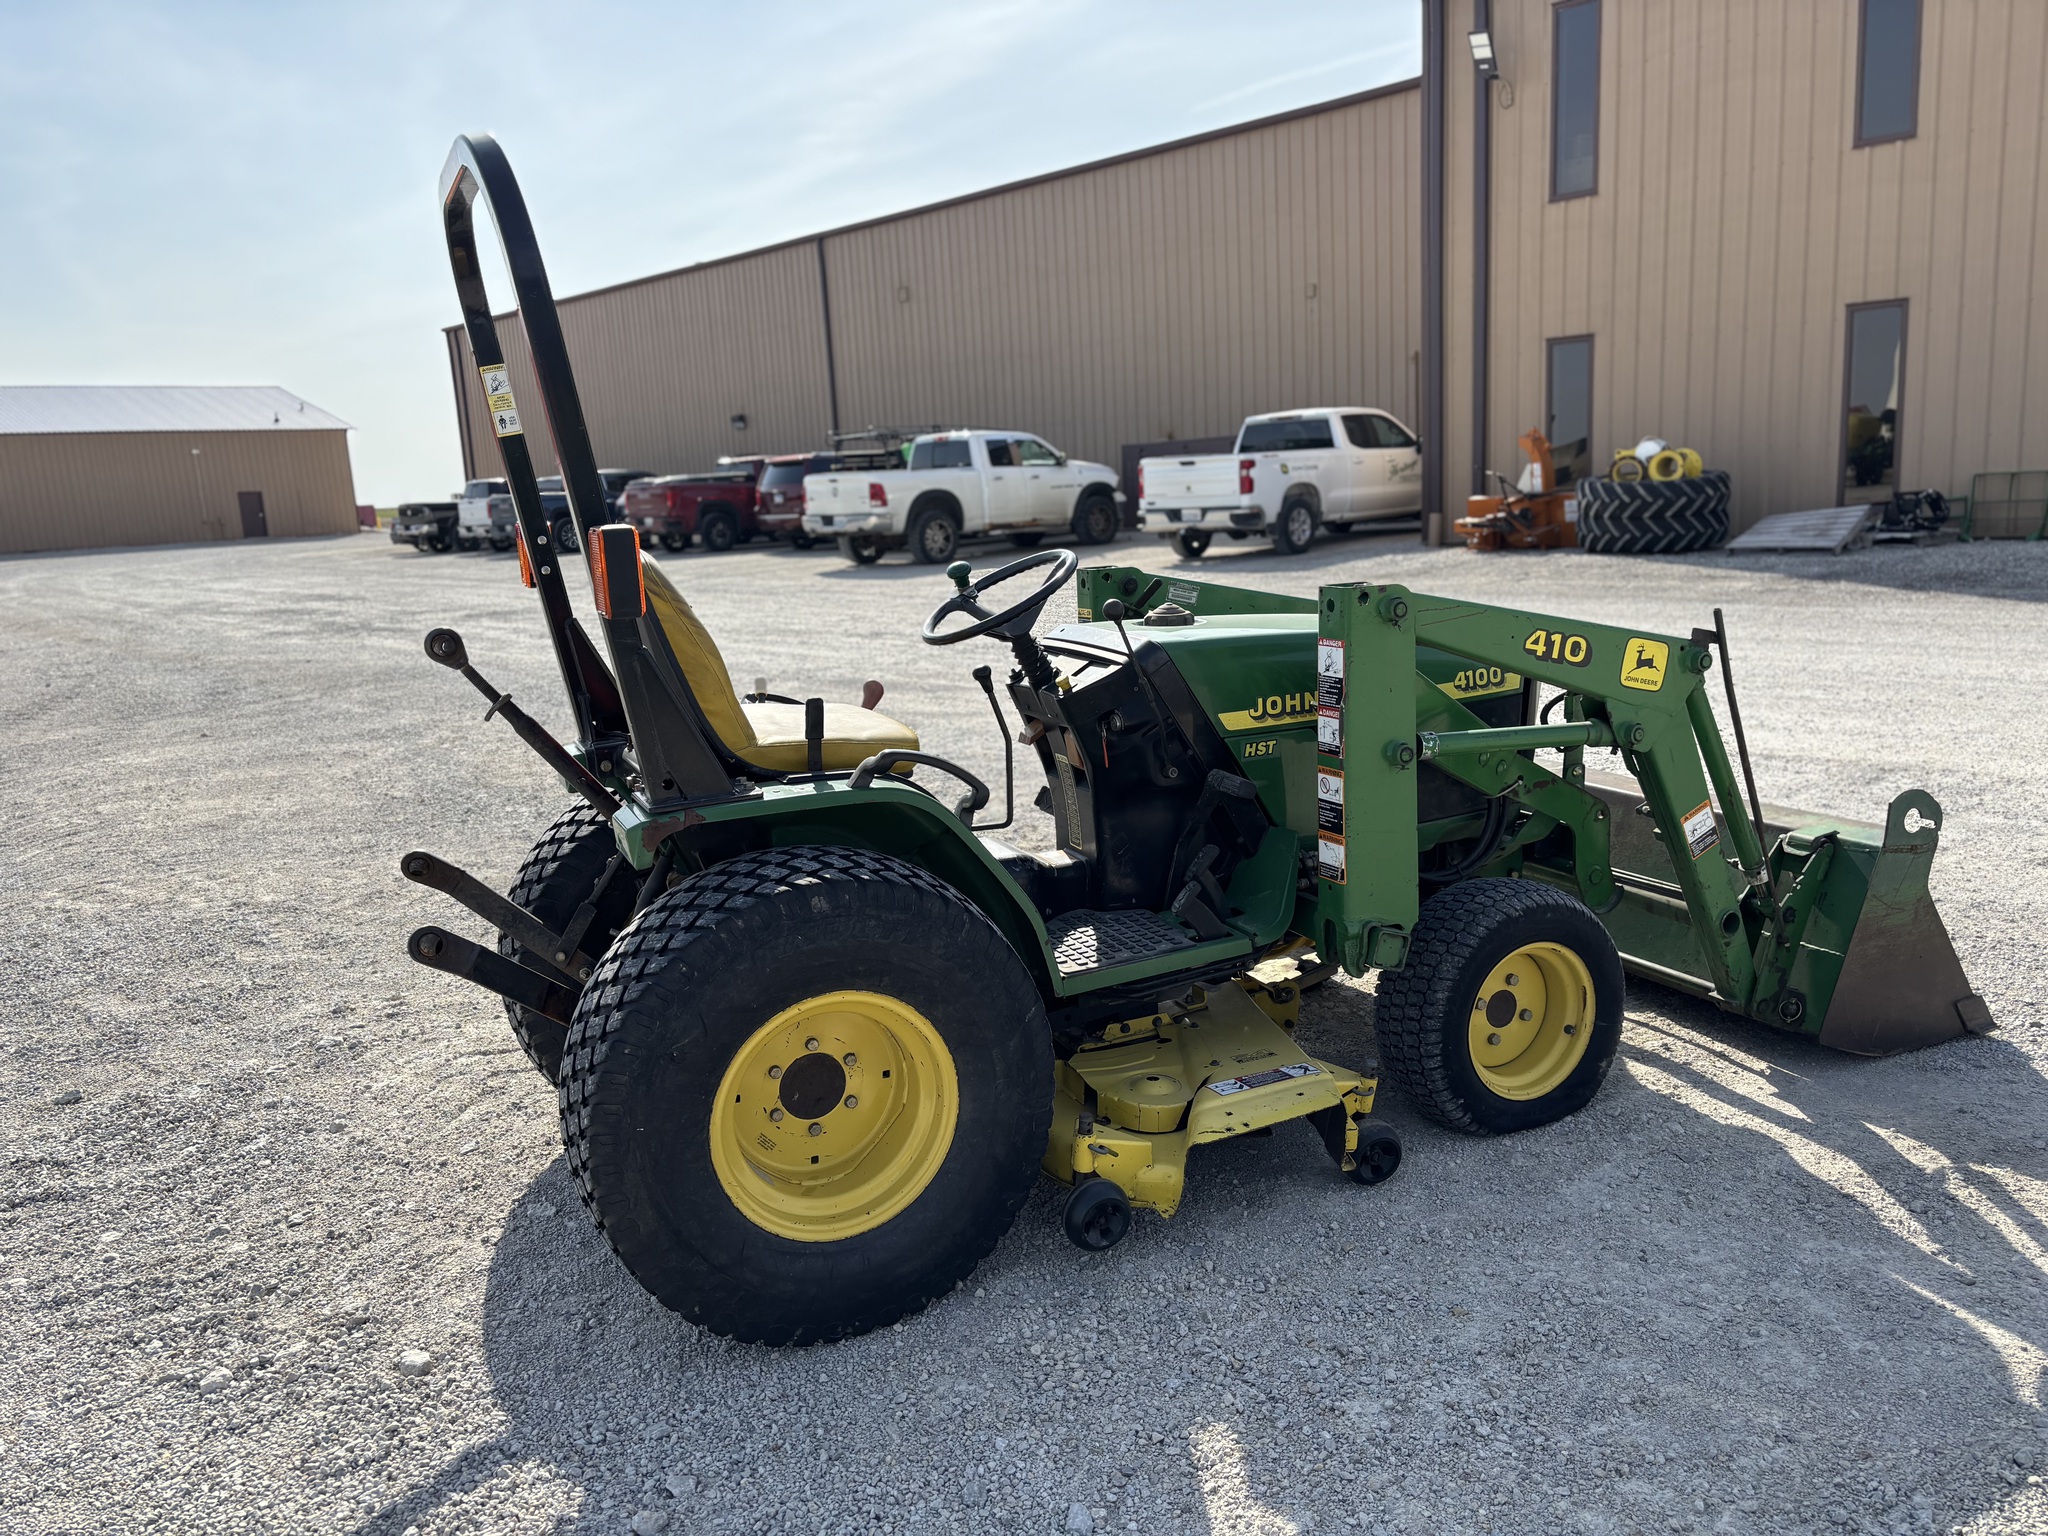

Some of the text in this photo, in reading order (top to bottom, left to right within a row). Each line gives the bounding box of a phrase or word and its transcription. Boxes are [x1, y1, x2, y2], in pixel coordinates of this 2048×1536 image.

[1323, 639, 1342, 648] DANGER
[1523, 629, 1590, 665] 410
[1454, 666, 1503, 690] 4100
[1624, 675, 1658, 687] JOHN DEERE
[1249, 690, 1318, 720] JOHN
[1244, 739, 1277, 758] HST
